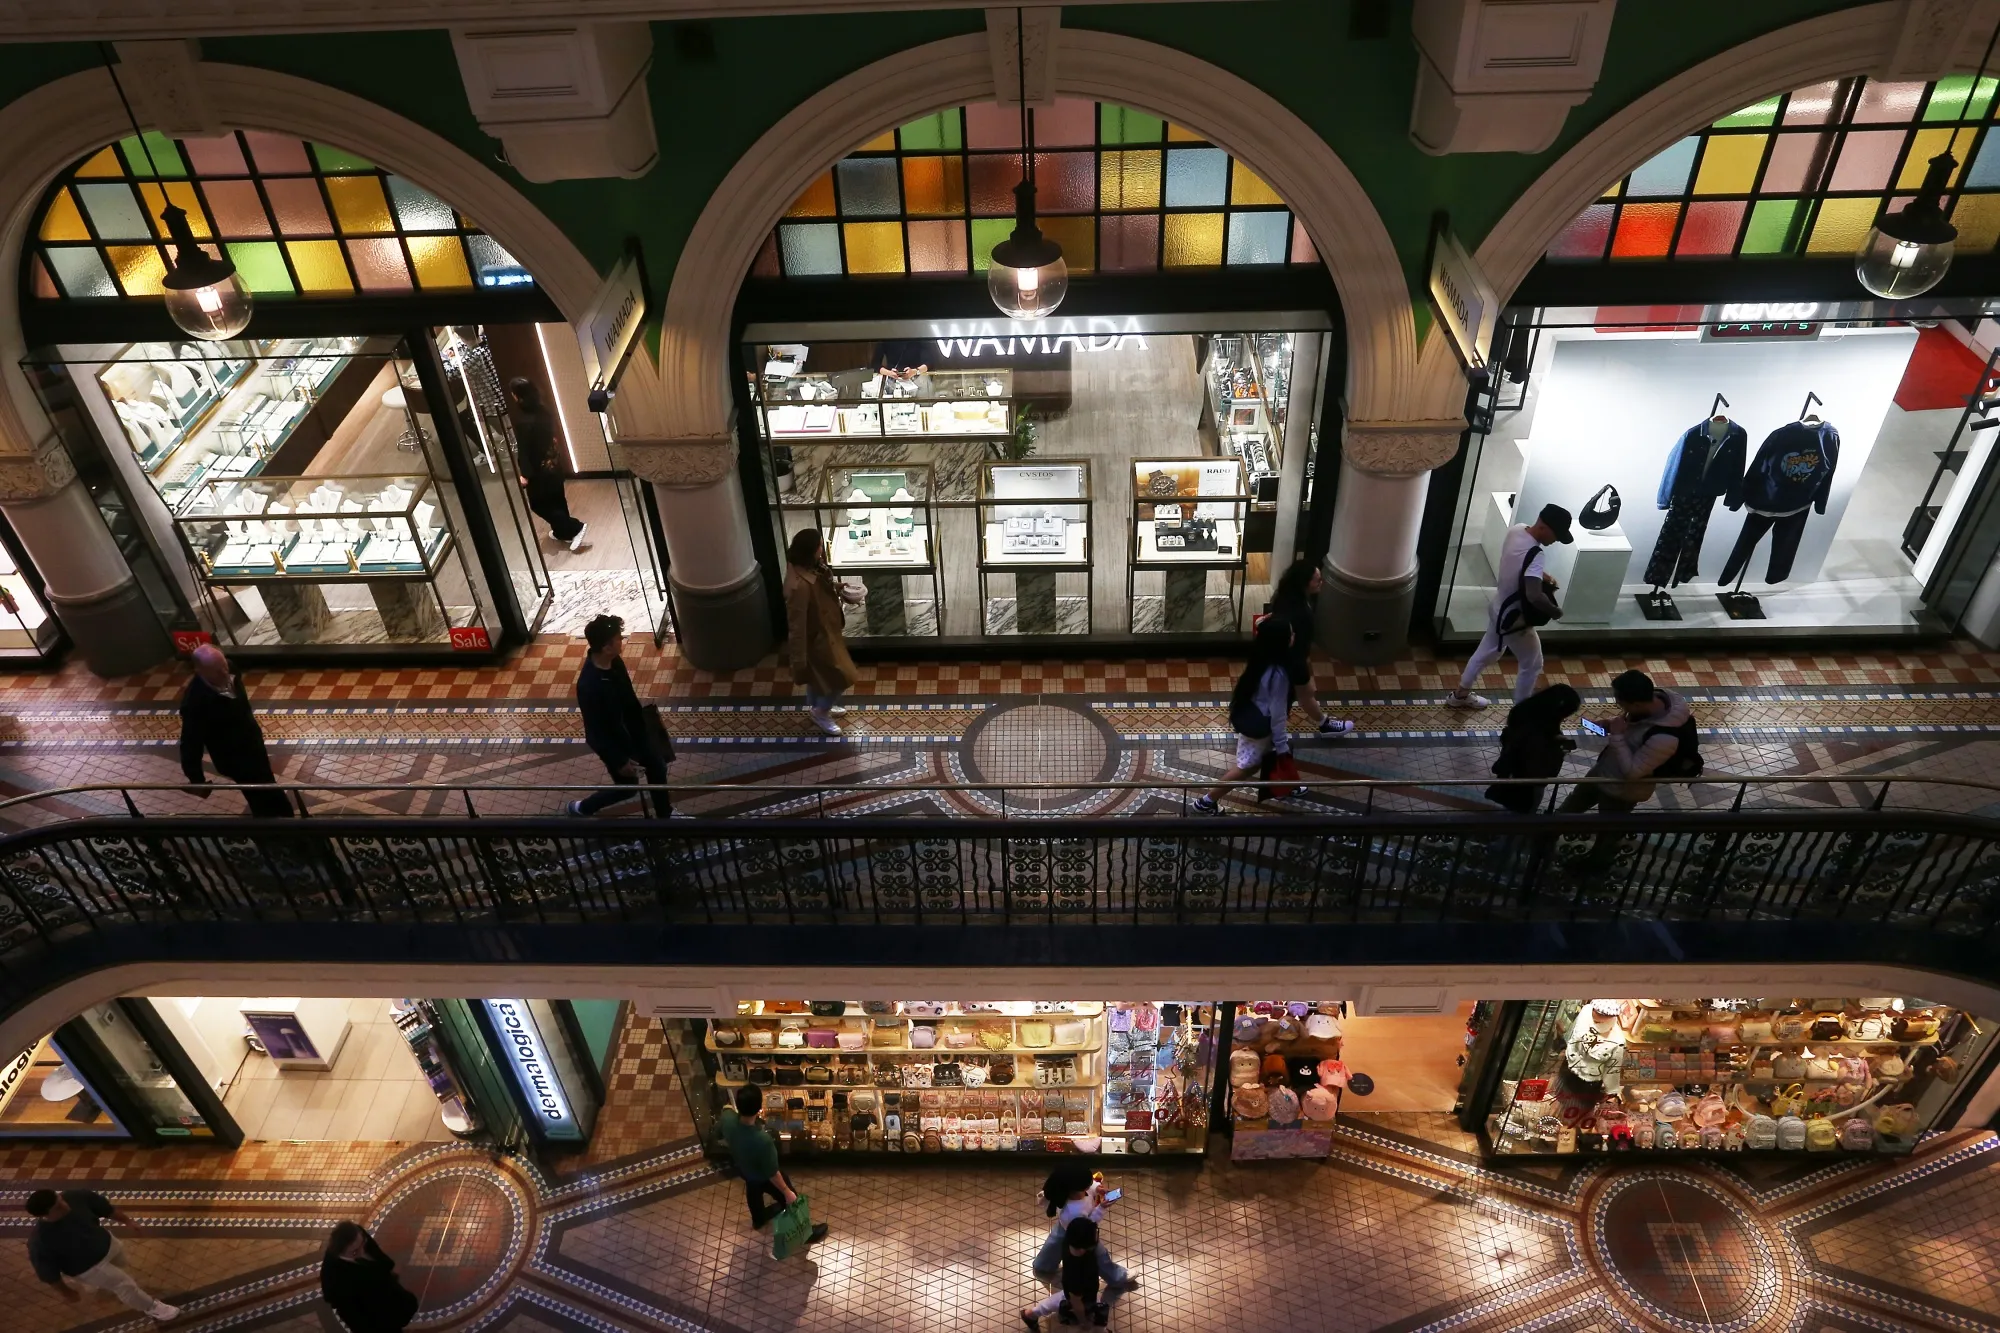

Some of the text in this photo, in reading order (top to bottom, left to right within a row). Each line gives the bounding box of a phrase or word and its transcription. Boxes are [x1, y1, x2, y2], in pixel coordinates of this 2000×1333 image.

[1439, 262, 1470, 332] WAMADA
[604, 289, 637, 352] WAMADA
[1720, 302, 1819, 321] KENZO
[1717, 322, 1809, 332] PARIS
[930, 315, 1150, 359] WAMADA
[571, 580, 658, 592] WAMAD
[177, 636, 209, 651] Sal
[453, 632, 488, 648] Sale
[498, 1002, 563, 1121] dermalogica
